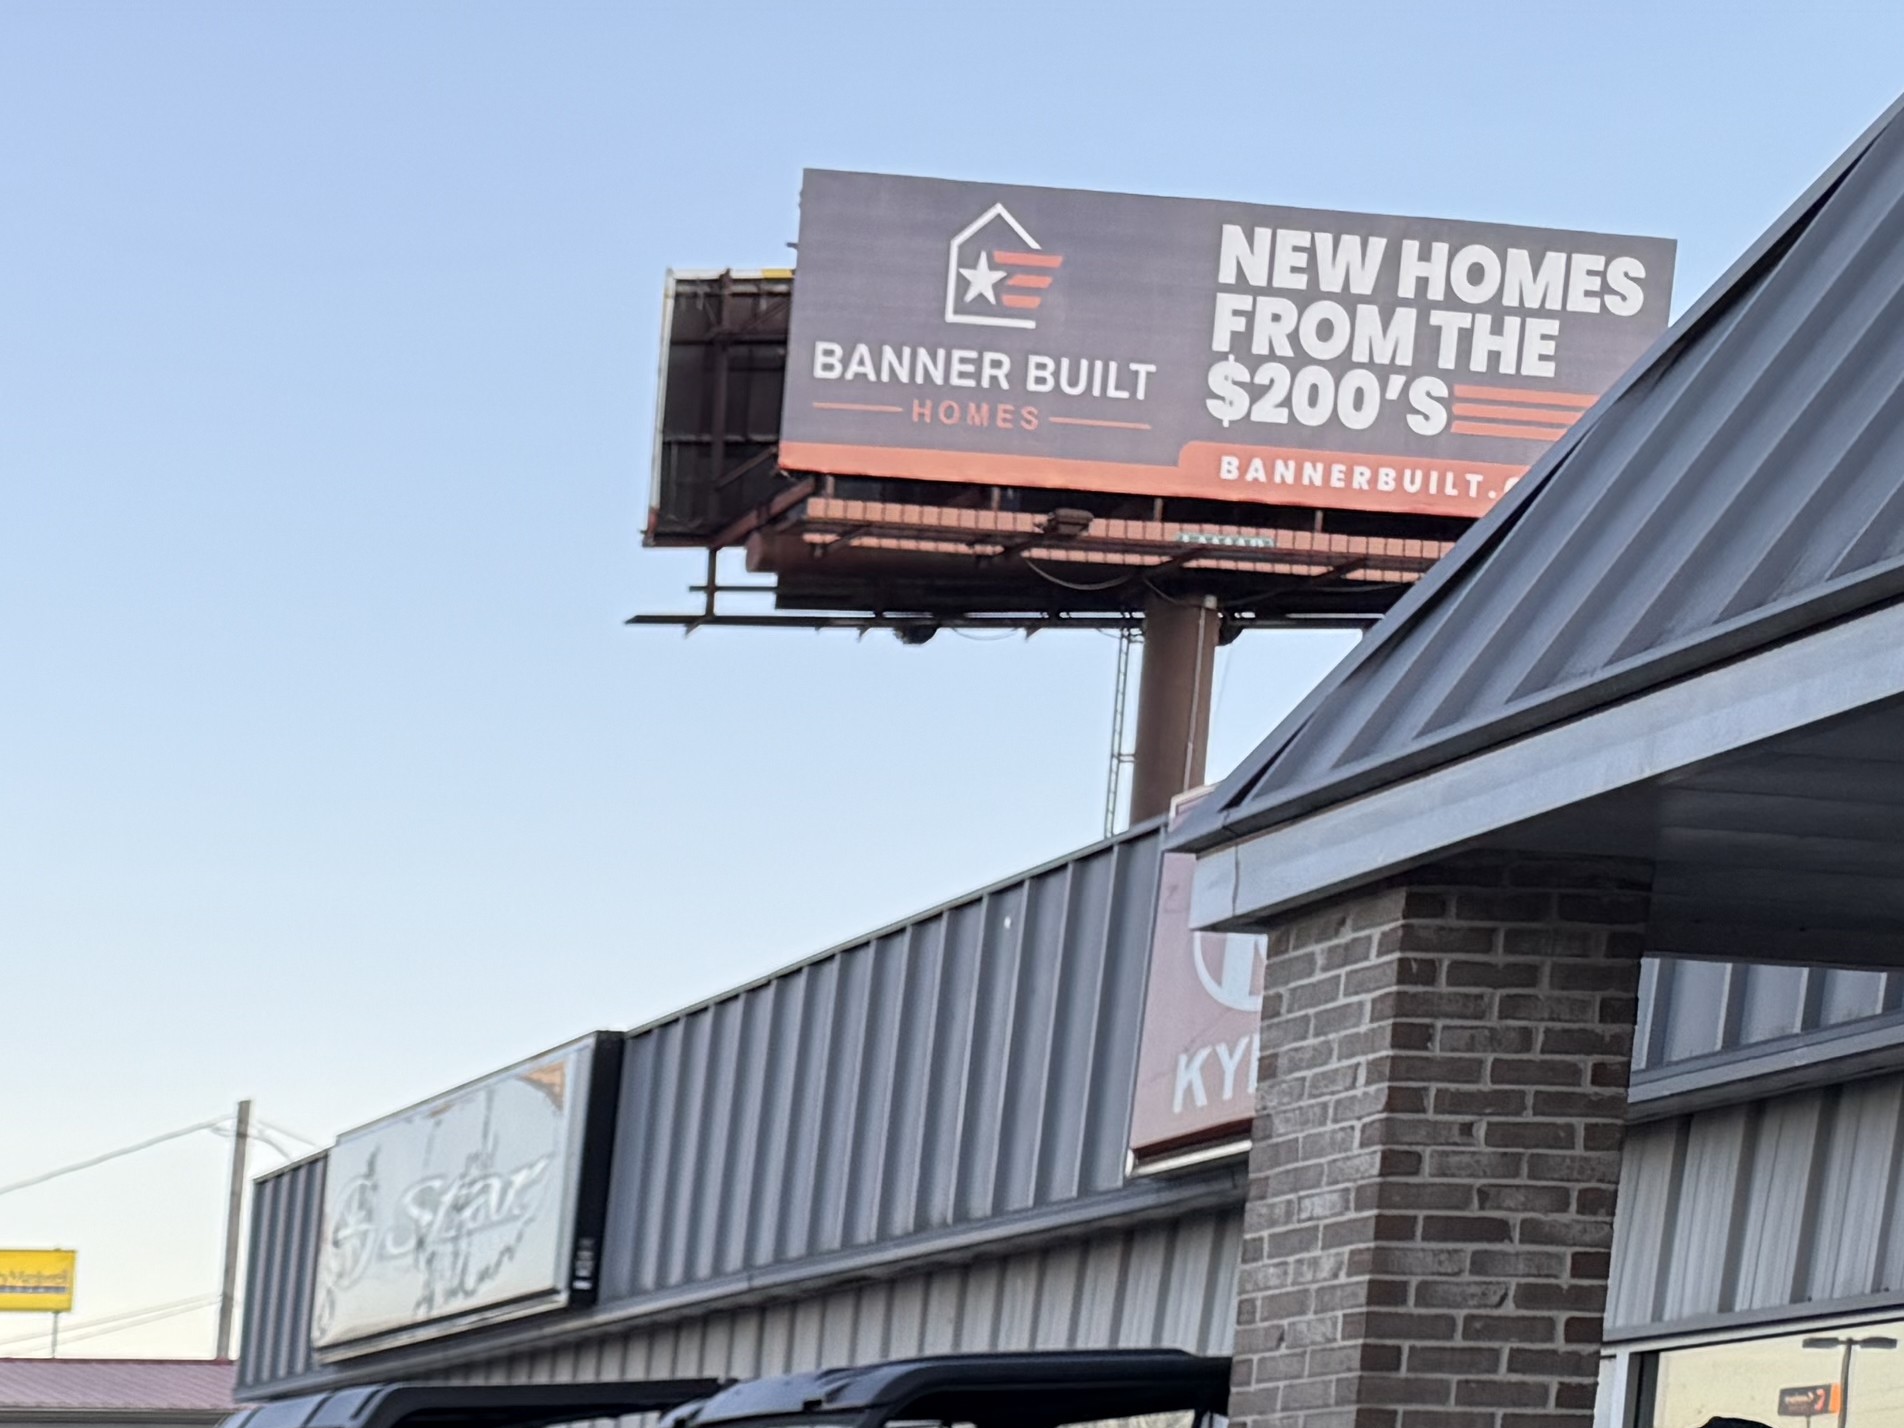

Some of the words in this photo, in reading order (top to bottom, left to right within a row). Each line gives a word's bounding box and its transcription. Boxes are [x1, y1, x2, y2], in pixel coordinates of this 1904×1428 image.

[1218, 224, 1387, 295] NEW
[1397, 239, 1646, 316] HOMES
[812, 341, 1010, 390] BANNER
[1026, 354, 1157, 400] BUILT
[1212, 292, 1417, 366] FROM
[1429, 310, 1560, 378] THE
[912, 398, 1039, 430] HOMES
[1205, 354, 1449, 436] $200'S
